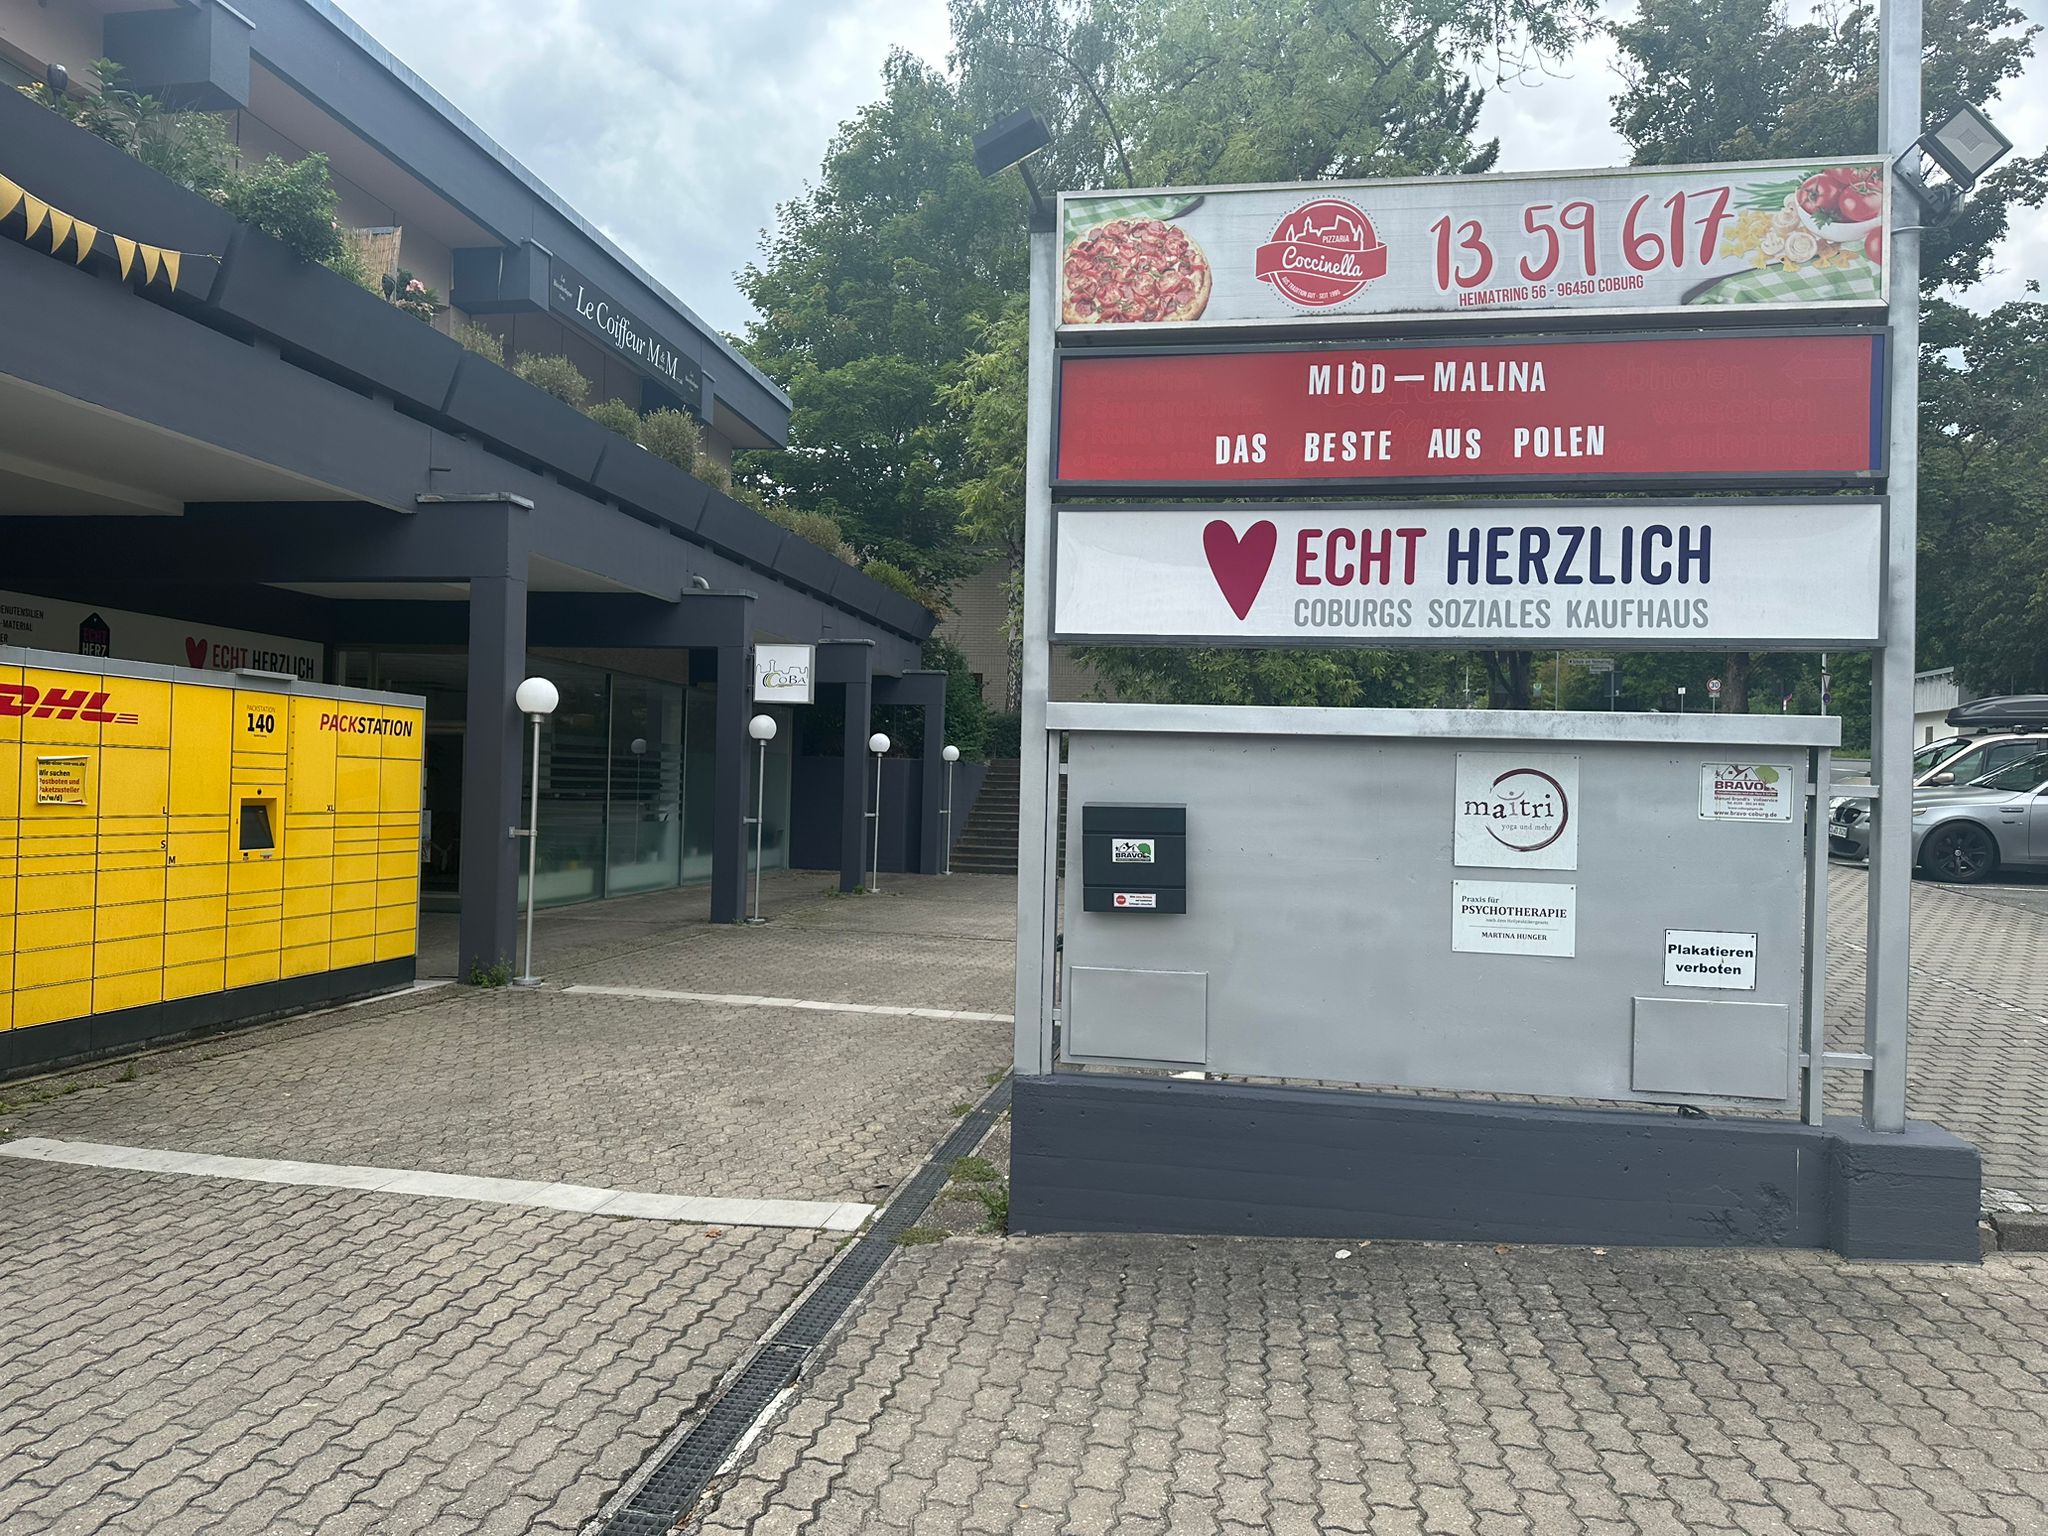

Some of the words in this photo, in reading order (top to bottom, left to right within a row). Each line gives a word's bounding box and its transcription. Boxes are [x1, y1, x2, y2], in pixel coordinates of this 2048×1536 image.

[1322, 235, 1350, 243] PIZZARIA
[1431, 215, 1493, 290] 13
[1520, 201, 1597, 282] 59
[1623, 186, 1735, 272] 617
[1282, 246, 1363, 276] Coccinella
[1460, 286, 1528, 307] HEIMATRING
[1531, 285, 1546, 299] 56
[1557, 280, 1595, 297] 96450
[1598, 275, 1644, 293] COBURG
[576, 285, 594, 319] Le
[597, 302, 645, 355] Coiffeur
[1433, 361, 1546, 392] MALINA
[1216, 433, 1267, 465] DAS
[1304, 431, 1391, 462] BESTE
[1428, 428, 1481, 459] AUS
[1513, 425, 1604, 458] POLEN
[1296, 527, 1427, 586] ECHT
[1446, 525, 1711, 585] HERZLICH
[1294, 598, 1412, 627] COBURGS
[1428, 598, 1550, 628] SOZIALES
[1567, 598, 1709, 629] KAUFHAUS
[213, 644, 248, 669] ECHT
[253, 650, 314, 679] HERZLICH
[0, 684, 117, 722] DHL
[248, 713, 275, 733] 140
[320, 714, 413, 737] PACKSTATION
[1714, 781, 1764, 790] BRAVO
[1464, 792, 1554, 819] maitri
[169, 856, 176, 864] M
[1461, 905, 1567, 918] PSYCHOTHERAPIE
[1517, 933, 1547, 941] HUNGER
[1668, 944, 1753, 958] Plakatieren
[1676, 963, 1741, 975] verboten
